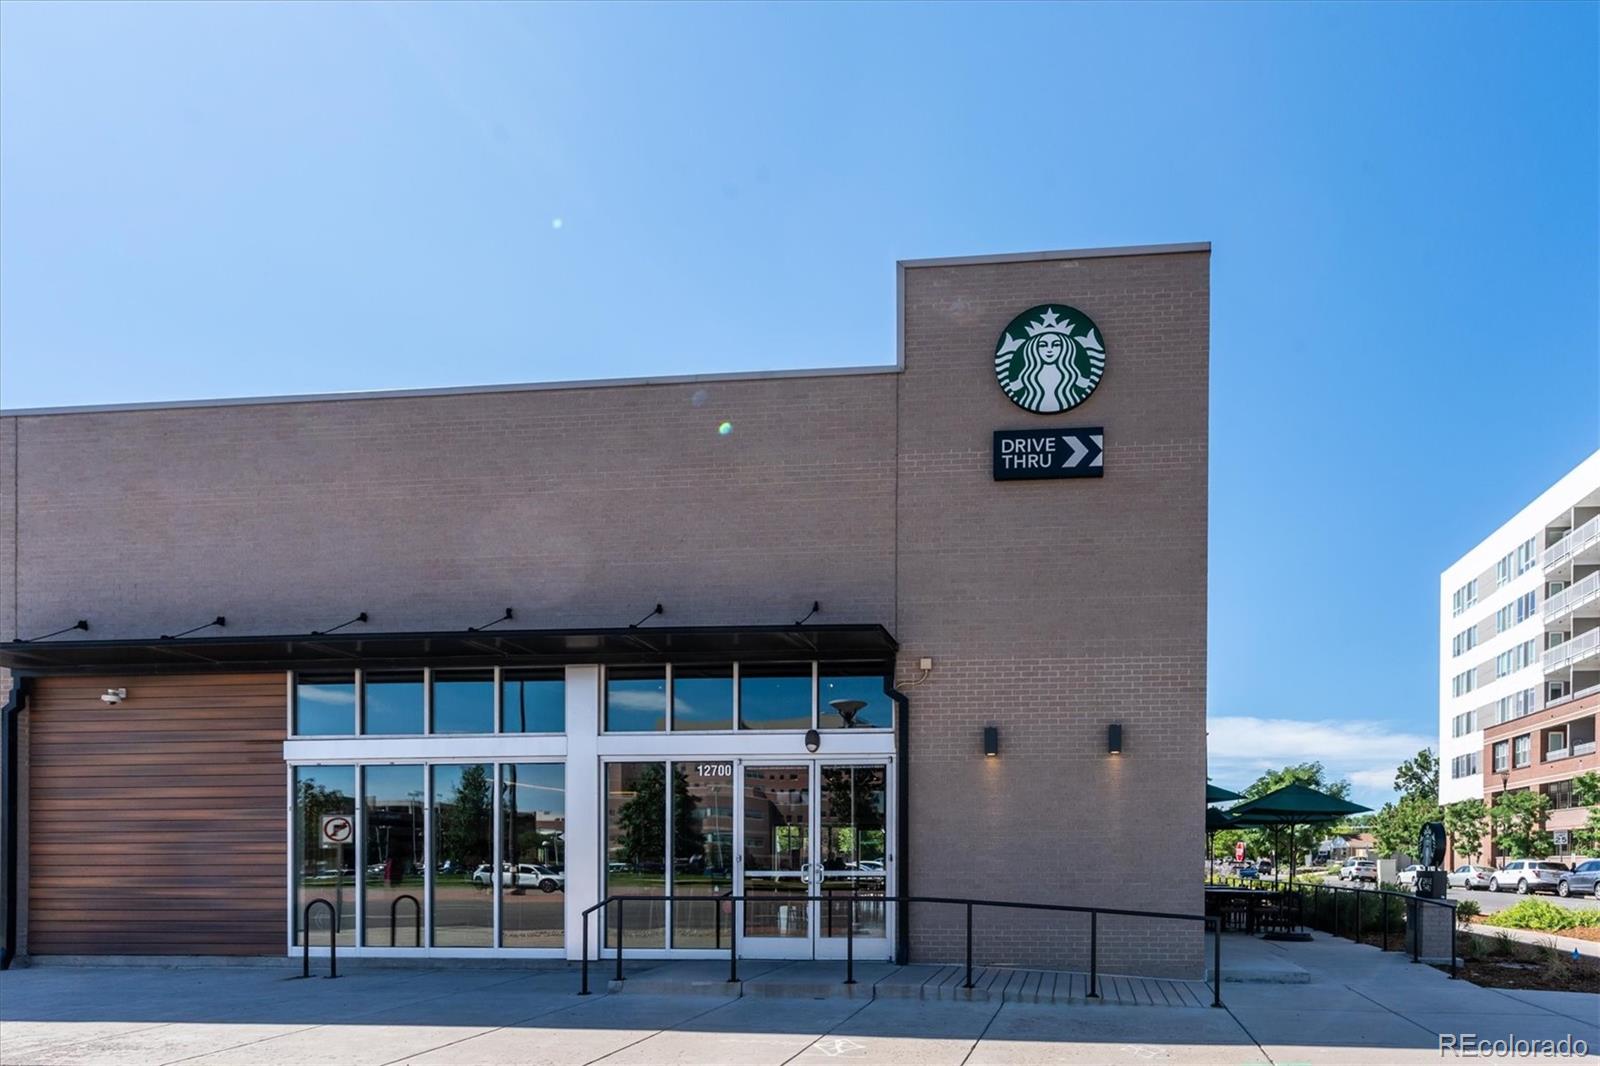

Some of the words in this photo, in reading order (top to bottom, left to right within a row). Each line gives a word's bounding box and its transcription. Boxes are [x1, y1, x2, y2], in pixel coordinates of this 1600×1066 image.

[1001, 437, 1056, 453] DRIVE
[1001, 453, 1052, 469] THRU
[697, 764, 732, 777] 12700
